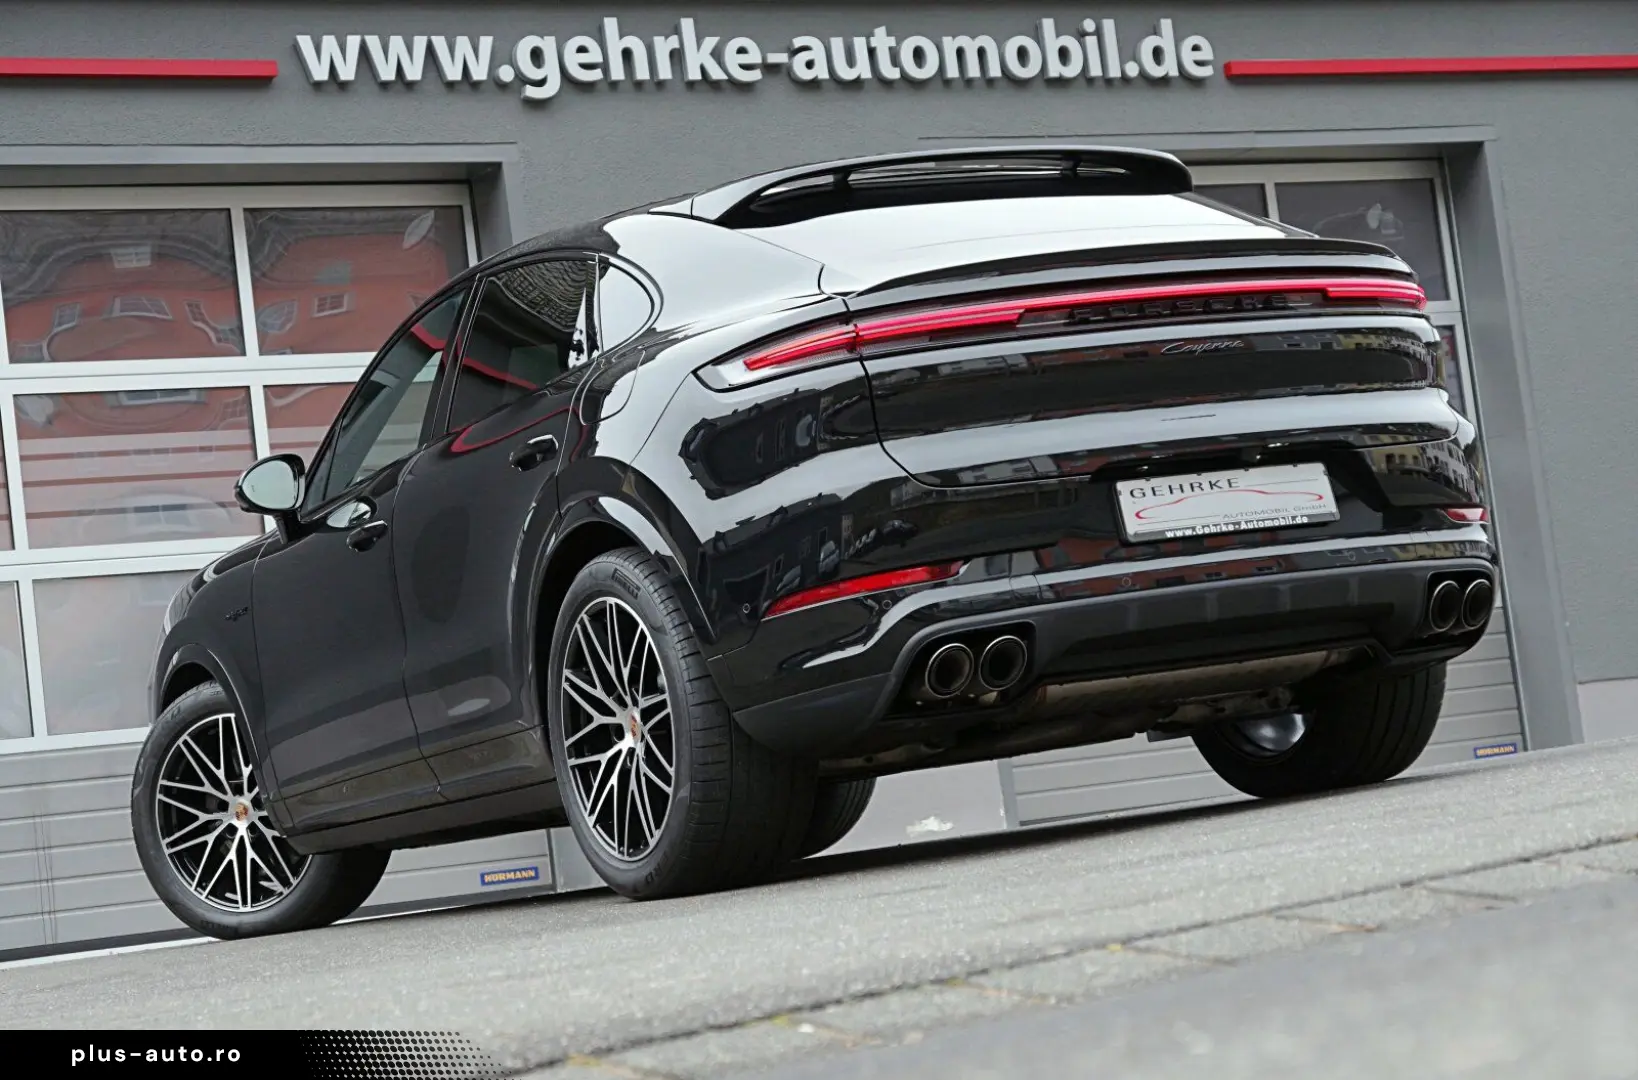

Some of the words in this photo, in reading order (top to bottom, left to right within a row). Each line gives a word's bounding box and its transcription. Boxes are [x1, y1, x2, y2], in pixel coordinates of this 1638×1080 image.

[296, 17, 1215, 101] www.gehrke-automobil.de
[1161, 340, 1245, 356] Cayenne
[1129, 478, 1240, 498] GEHRKE
[1165, 515, 1309, 538] www.Gehrke-Automobil.de
